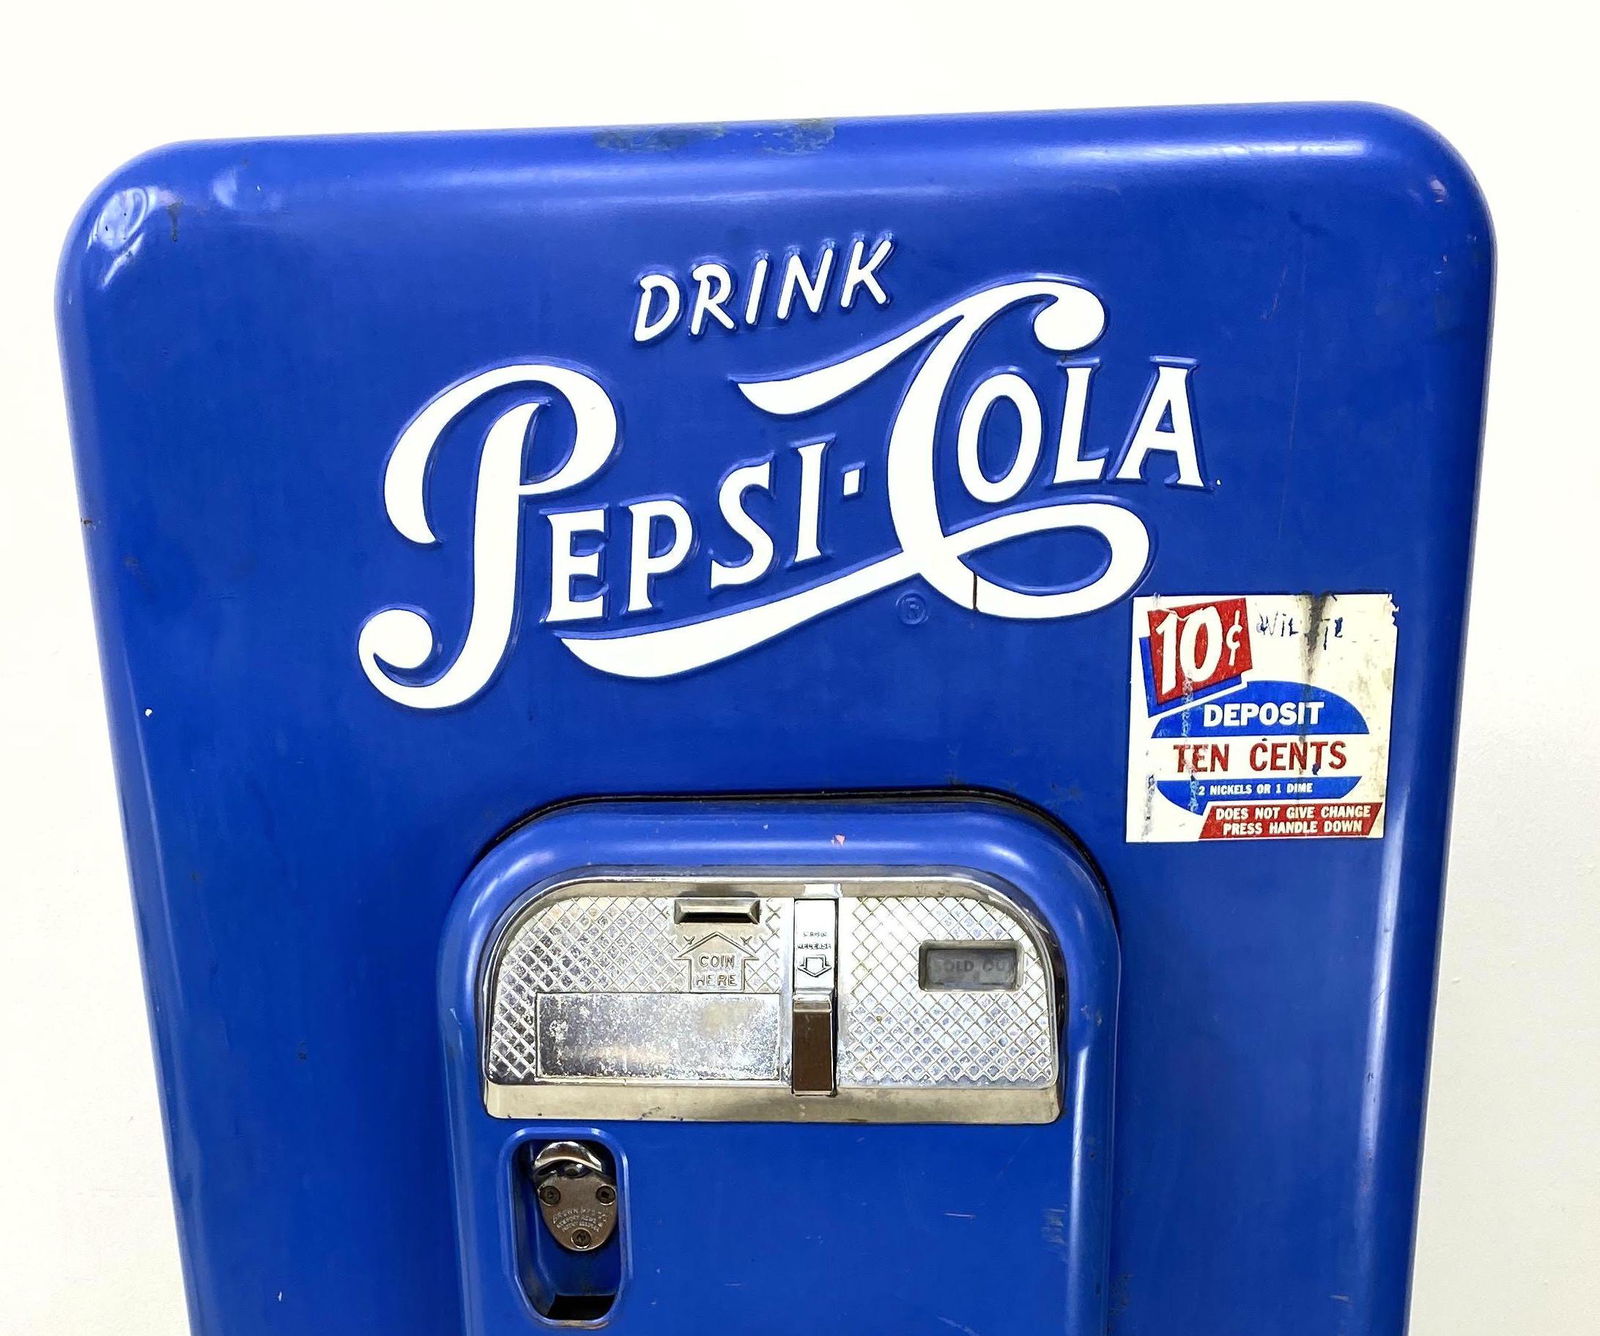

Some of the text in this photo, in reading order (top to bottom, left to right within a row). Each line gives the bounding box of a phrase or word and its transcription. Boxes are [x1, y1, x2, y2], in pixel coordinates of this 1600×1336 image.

[634, 240, 893, 342] DRINK
[1203, 701, 1325, 728] DEPOSIT
[1173, 741, 1348, 773] TEN CENTS
[1198, 782, 1313, 796] 2 NICKELS OR 1 DIME
[1215, 805, 1372, 821] DOES NOT GIVE CHANGE
[1223, 820, 1363, 836] PRESS HANDLE DOWN
[699, 954, 736, 969] COIN
[694, 974, 738, 986] HERE
